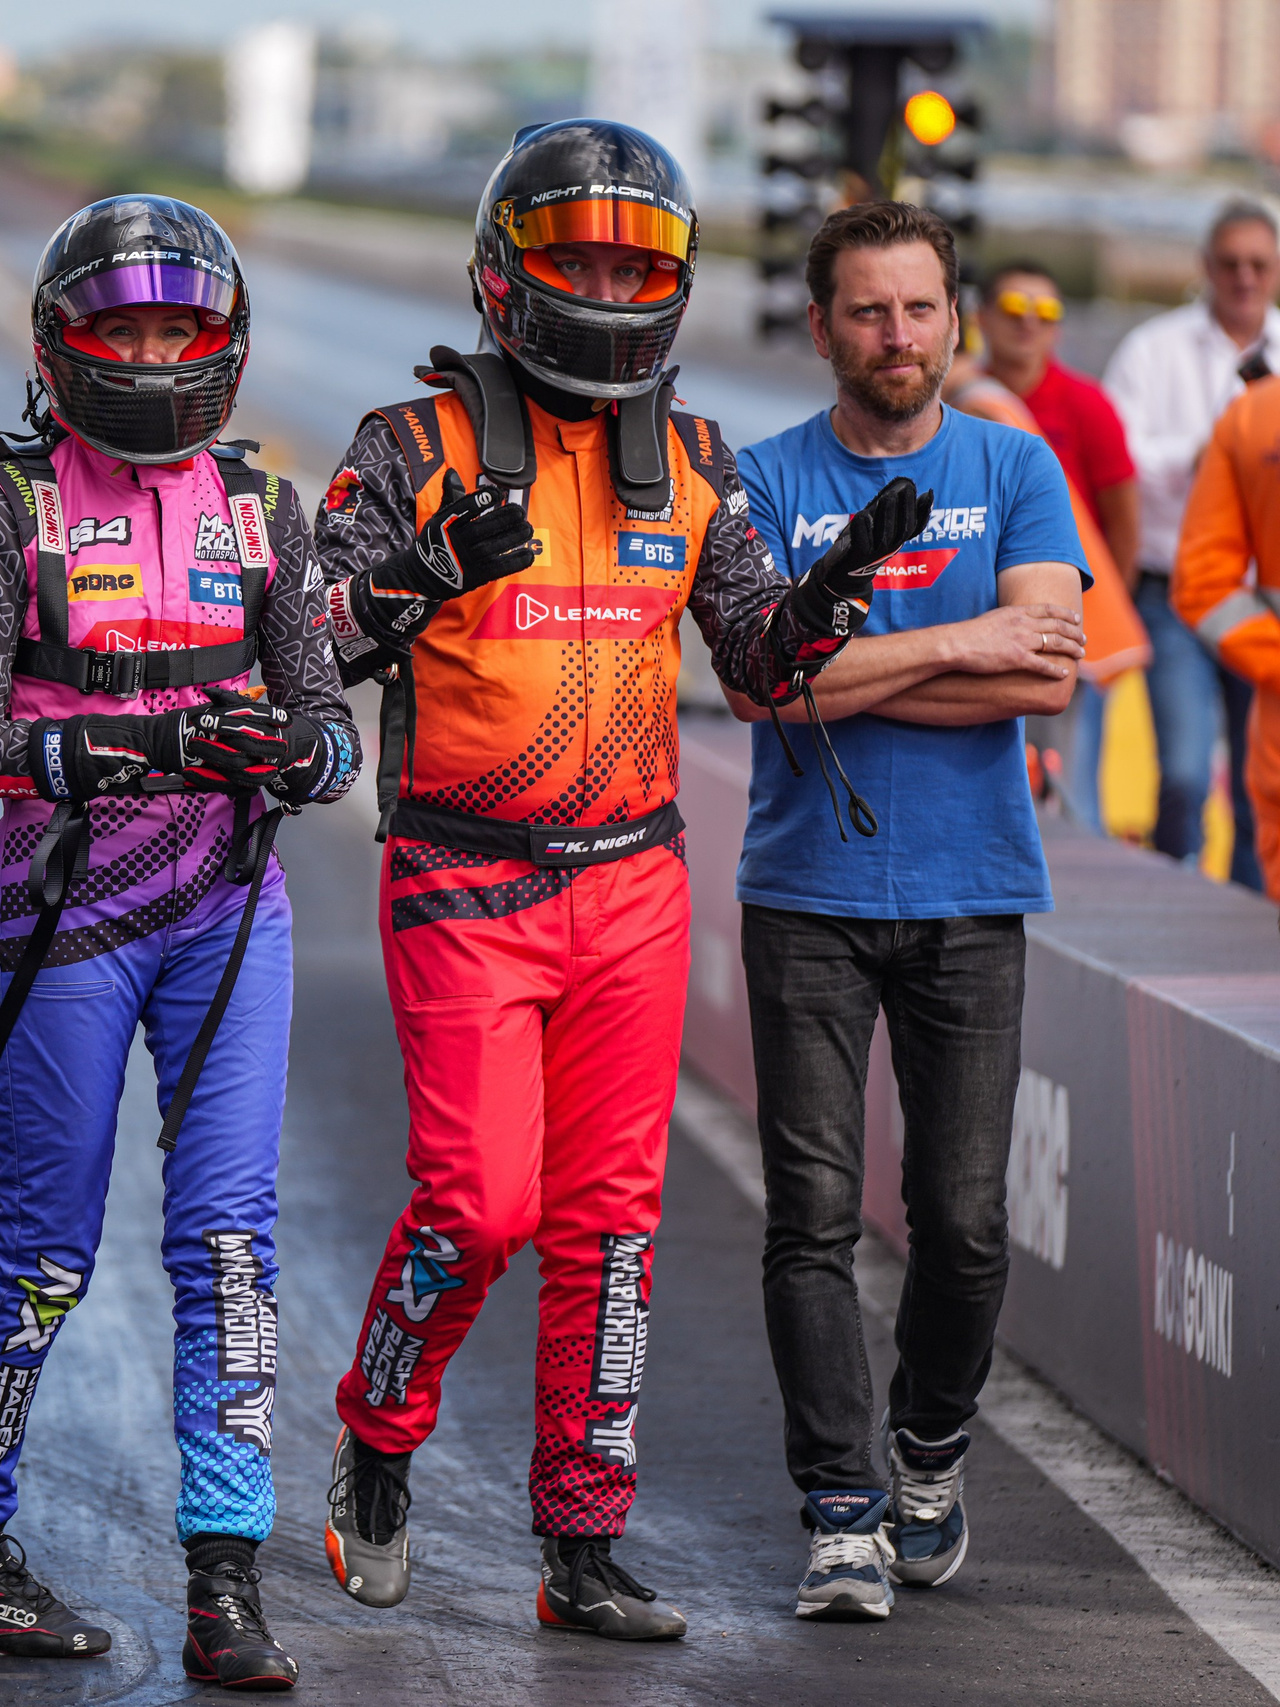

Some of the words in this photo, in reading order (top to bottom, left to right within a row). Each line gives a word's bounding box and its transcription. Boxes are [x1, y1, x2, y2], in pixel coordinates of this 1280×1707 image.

[531, 186, 582, 205] NIGHT
[590, 185, 654, 201] RACER
[59, 258, 104, 290] NIGHT
[112, 250, 181, 263] RACER
[190, 256, 232, 282] TEAM
[399, 406, 435, 463] MARINA
[40, 488, 60, 547] SIMPSON
[238, 502, 264, 560] SIMPSON
[644, 543, 675, 564] ВТБ
[876, 564, 927, 576] EMARC
[70, 573, 135, 594] RDRC
[554, 605, 642, 621] LEMARC
[45, 733, 69, 796] sparco
[564, 841, 589, 853] K.
[592, 827, 647, 852] NIGHT
[365, 1320, 404, 1407] RACER
[390, 1335, 424, 1405] NIGHT
[11, 1366, 41, 1449] NIGHT
